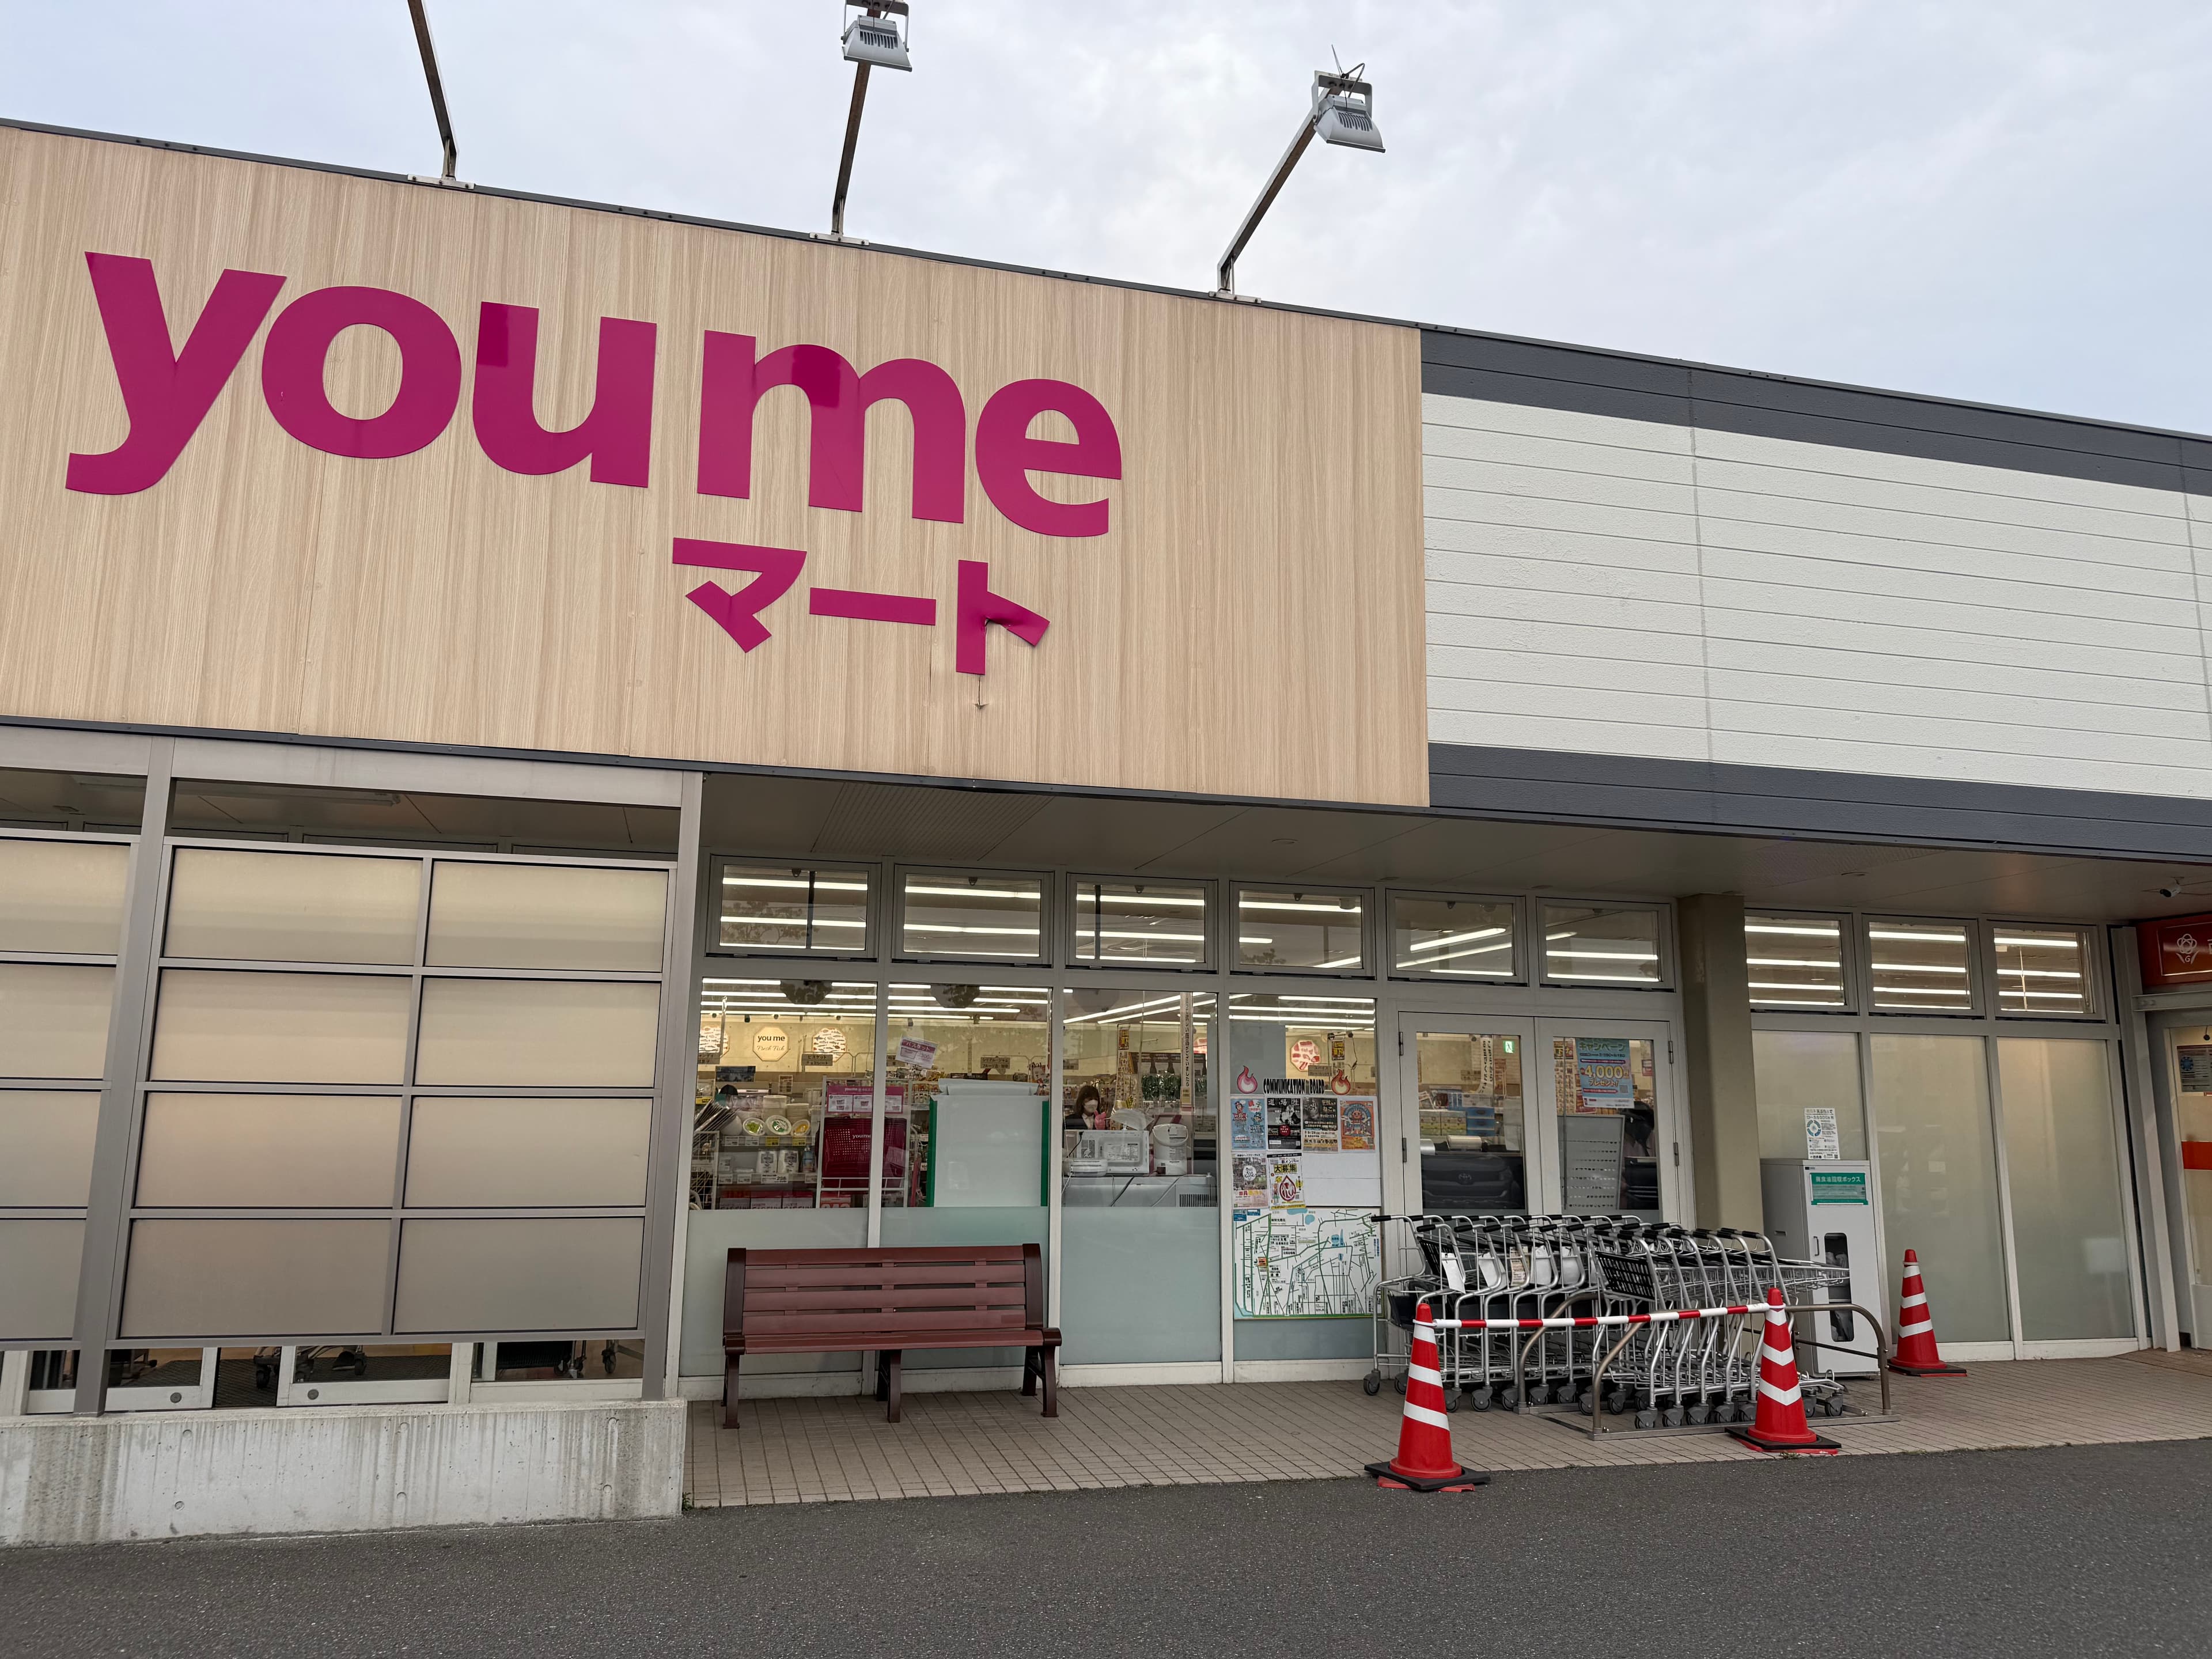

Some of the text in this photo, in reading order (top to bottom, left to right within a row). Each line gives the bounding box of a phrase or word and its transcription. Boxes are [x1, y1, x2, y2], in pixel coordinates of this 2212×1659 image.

[672, 537, 1050, 675] マート
[1580, 1041, 1625, 1051] キャンペーン
[1585, 1065, 1623, 1078] 4,000
[1263, 1078, 1325, 1094] COMMUNICATION BOARD
[1274, 1164, 1296, 1173] 大募集
